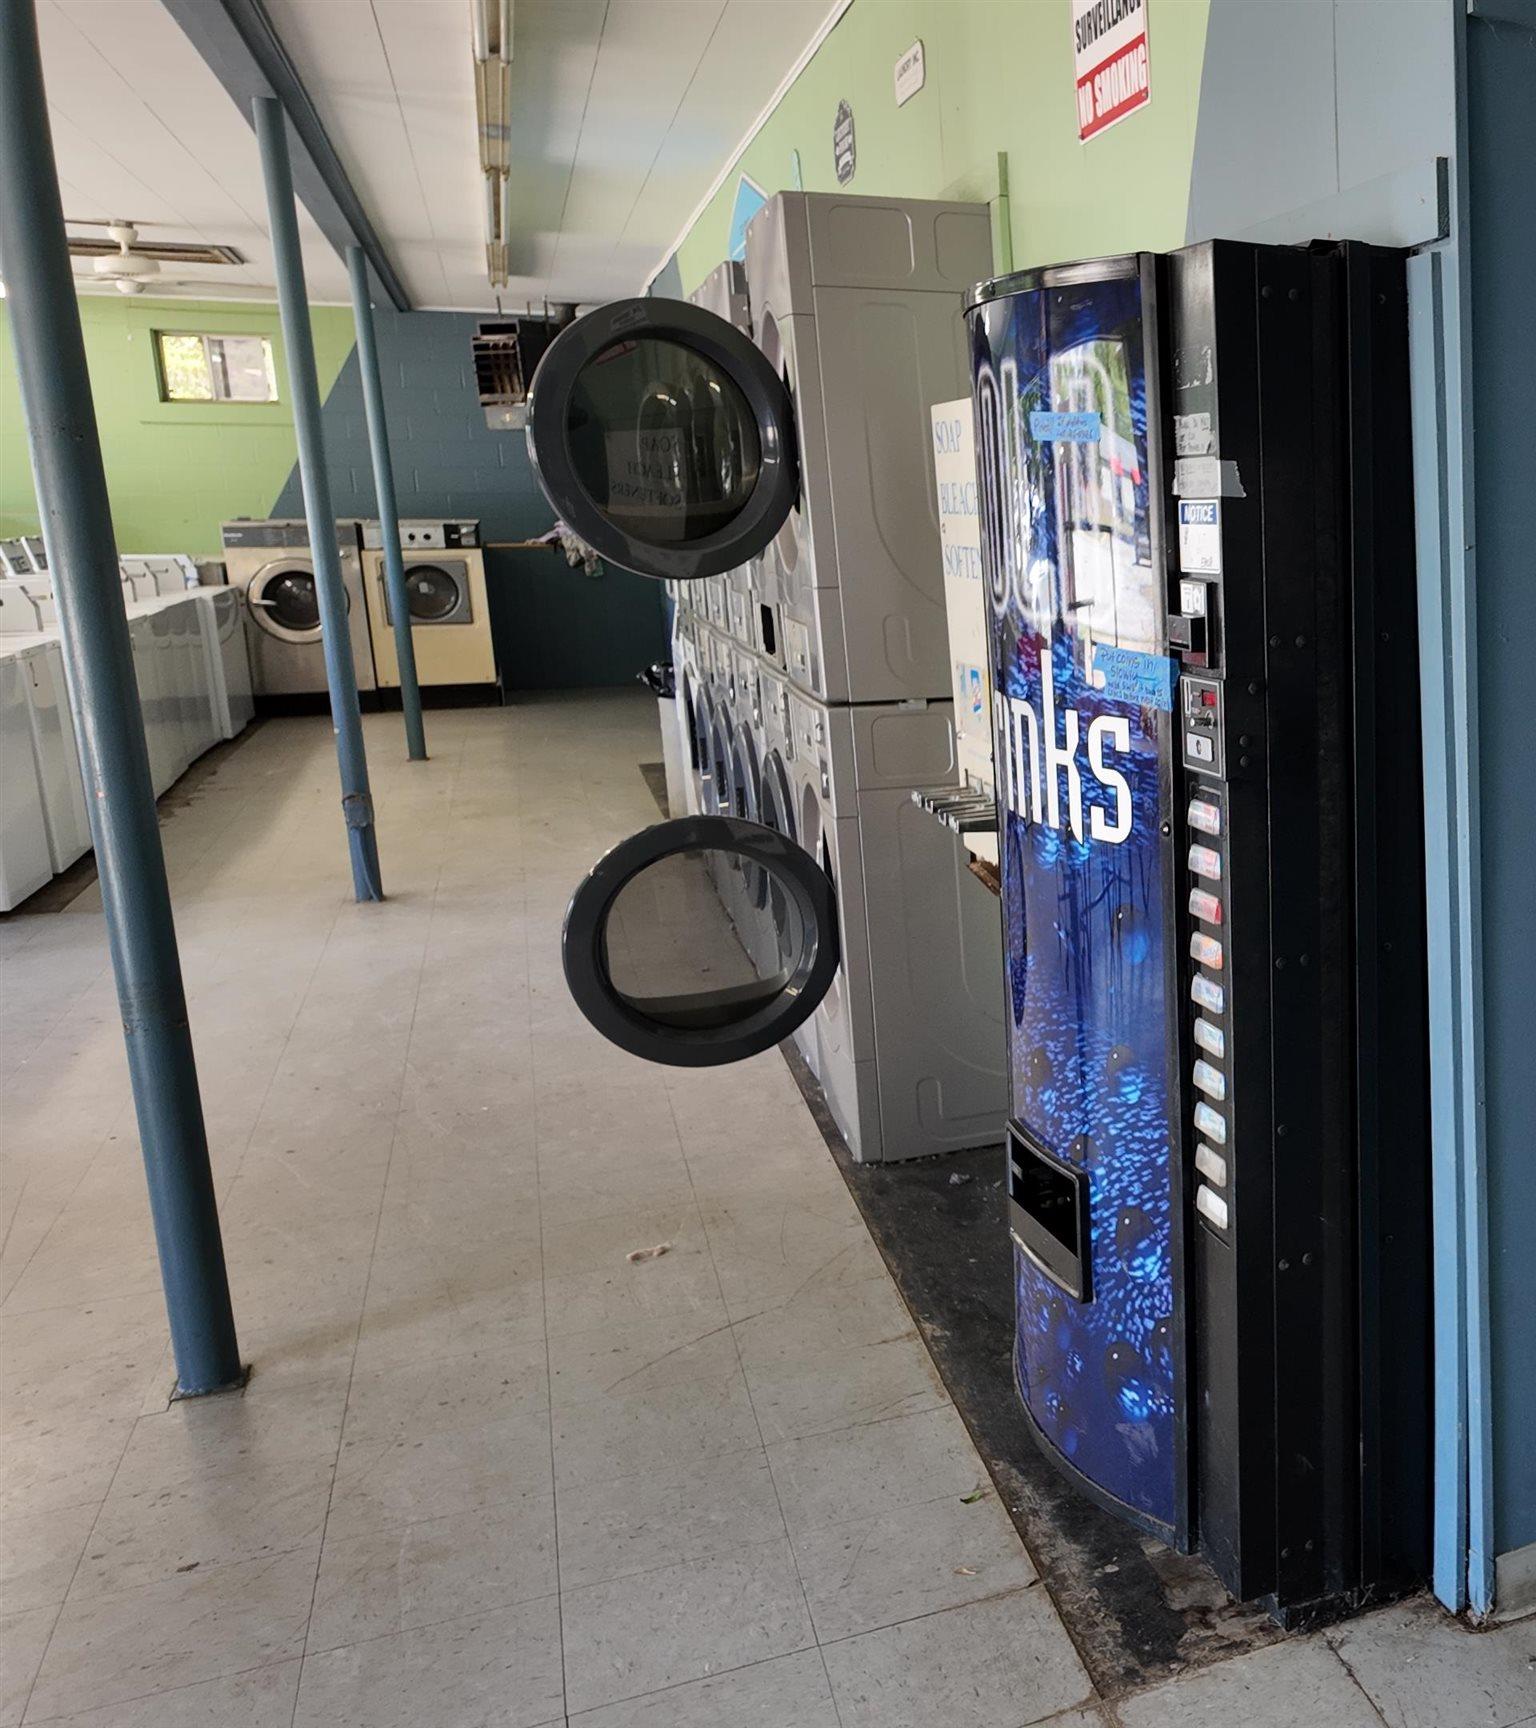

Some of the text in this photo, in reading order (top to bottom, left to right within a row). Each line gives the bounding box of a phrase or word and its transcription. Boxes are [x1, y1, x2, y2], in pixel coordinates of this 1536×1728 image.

[1075, 0, 1142, 54] SURVEILLAN
[1078, 43, 1147, 129] NO SMOKING
[935, 419, 962, 454] SOAP
[1183, 504, 1214, 522] NOTICE
